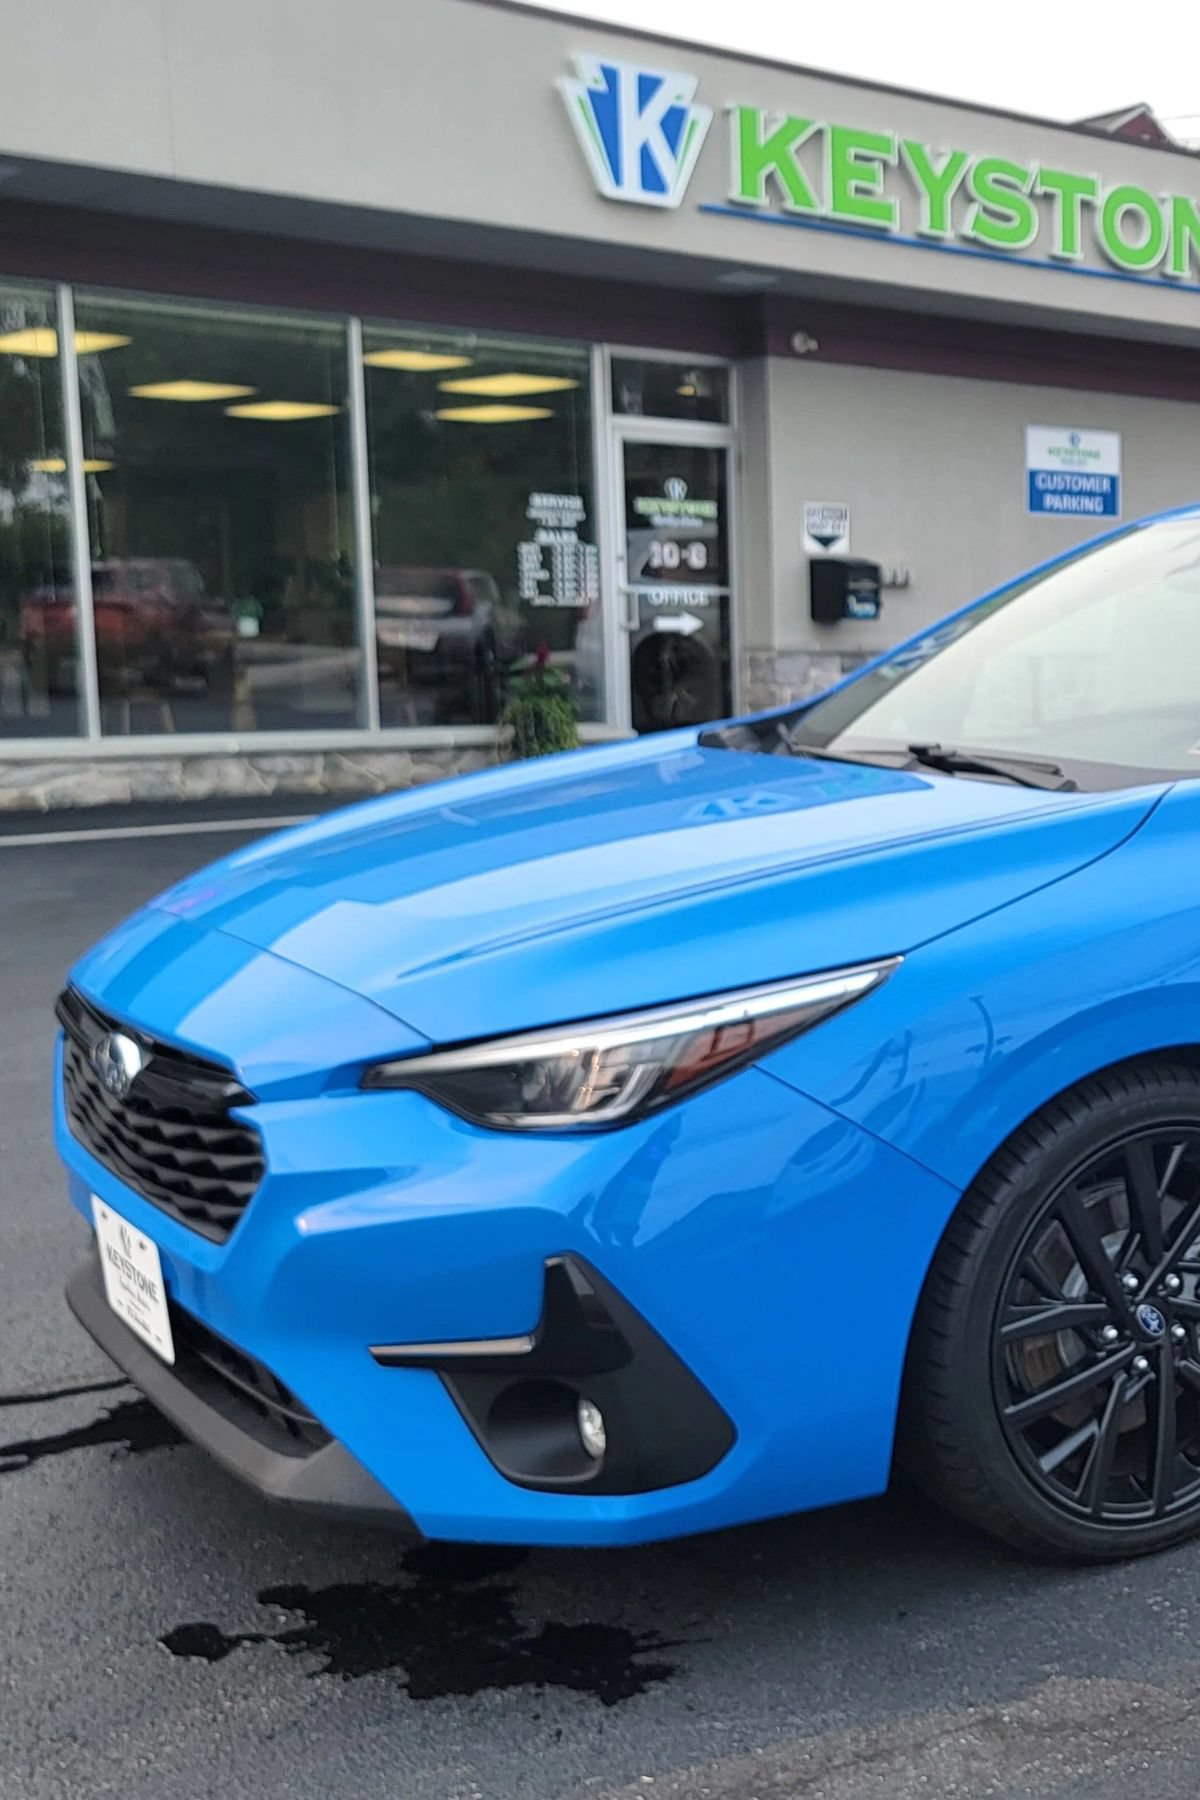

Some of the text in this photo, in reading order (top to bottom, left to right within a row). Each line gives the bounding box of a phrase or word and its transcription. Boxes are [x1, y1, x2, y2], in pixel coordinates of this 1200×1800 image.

[1034, 472, 1111, 494] CUSTOMER
[1043, 492, 1104, 513] PARKING
[105, 1241, 160, 1304] KEYSTONE
